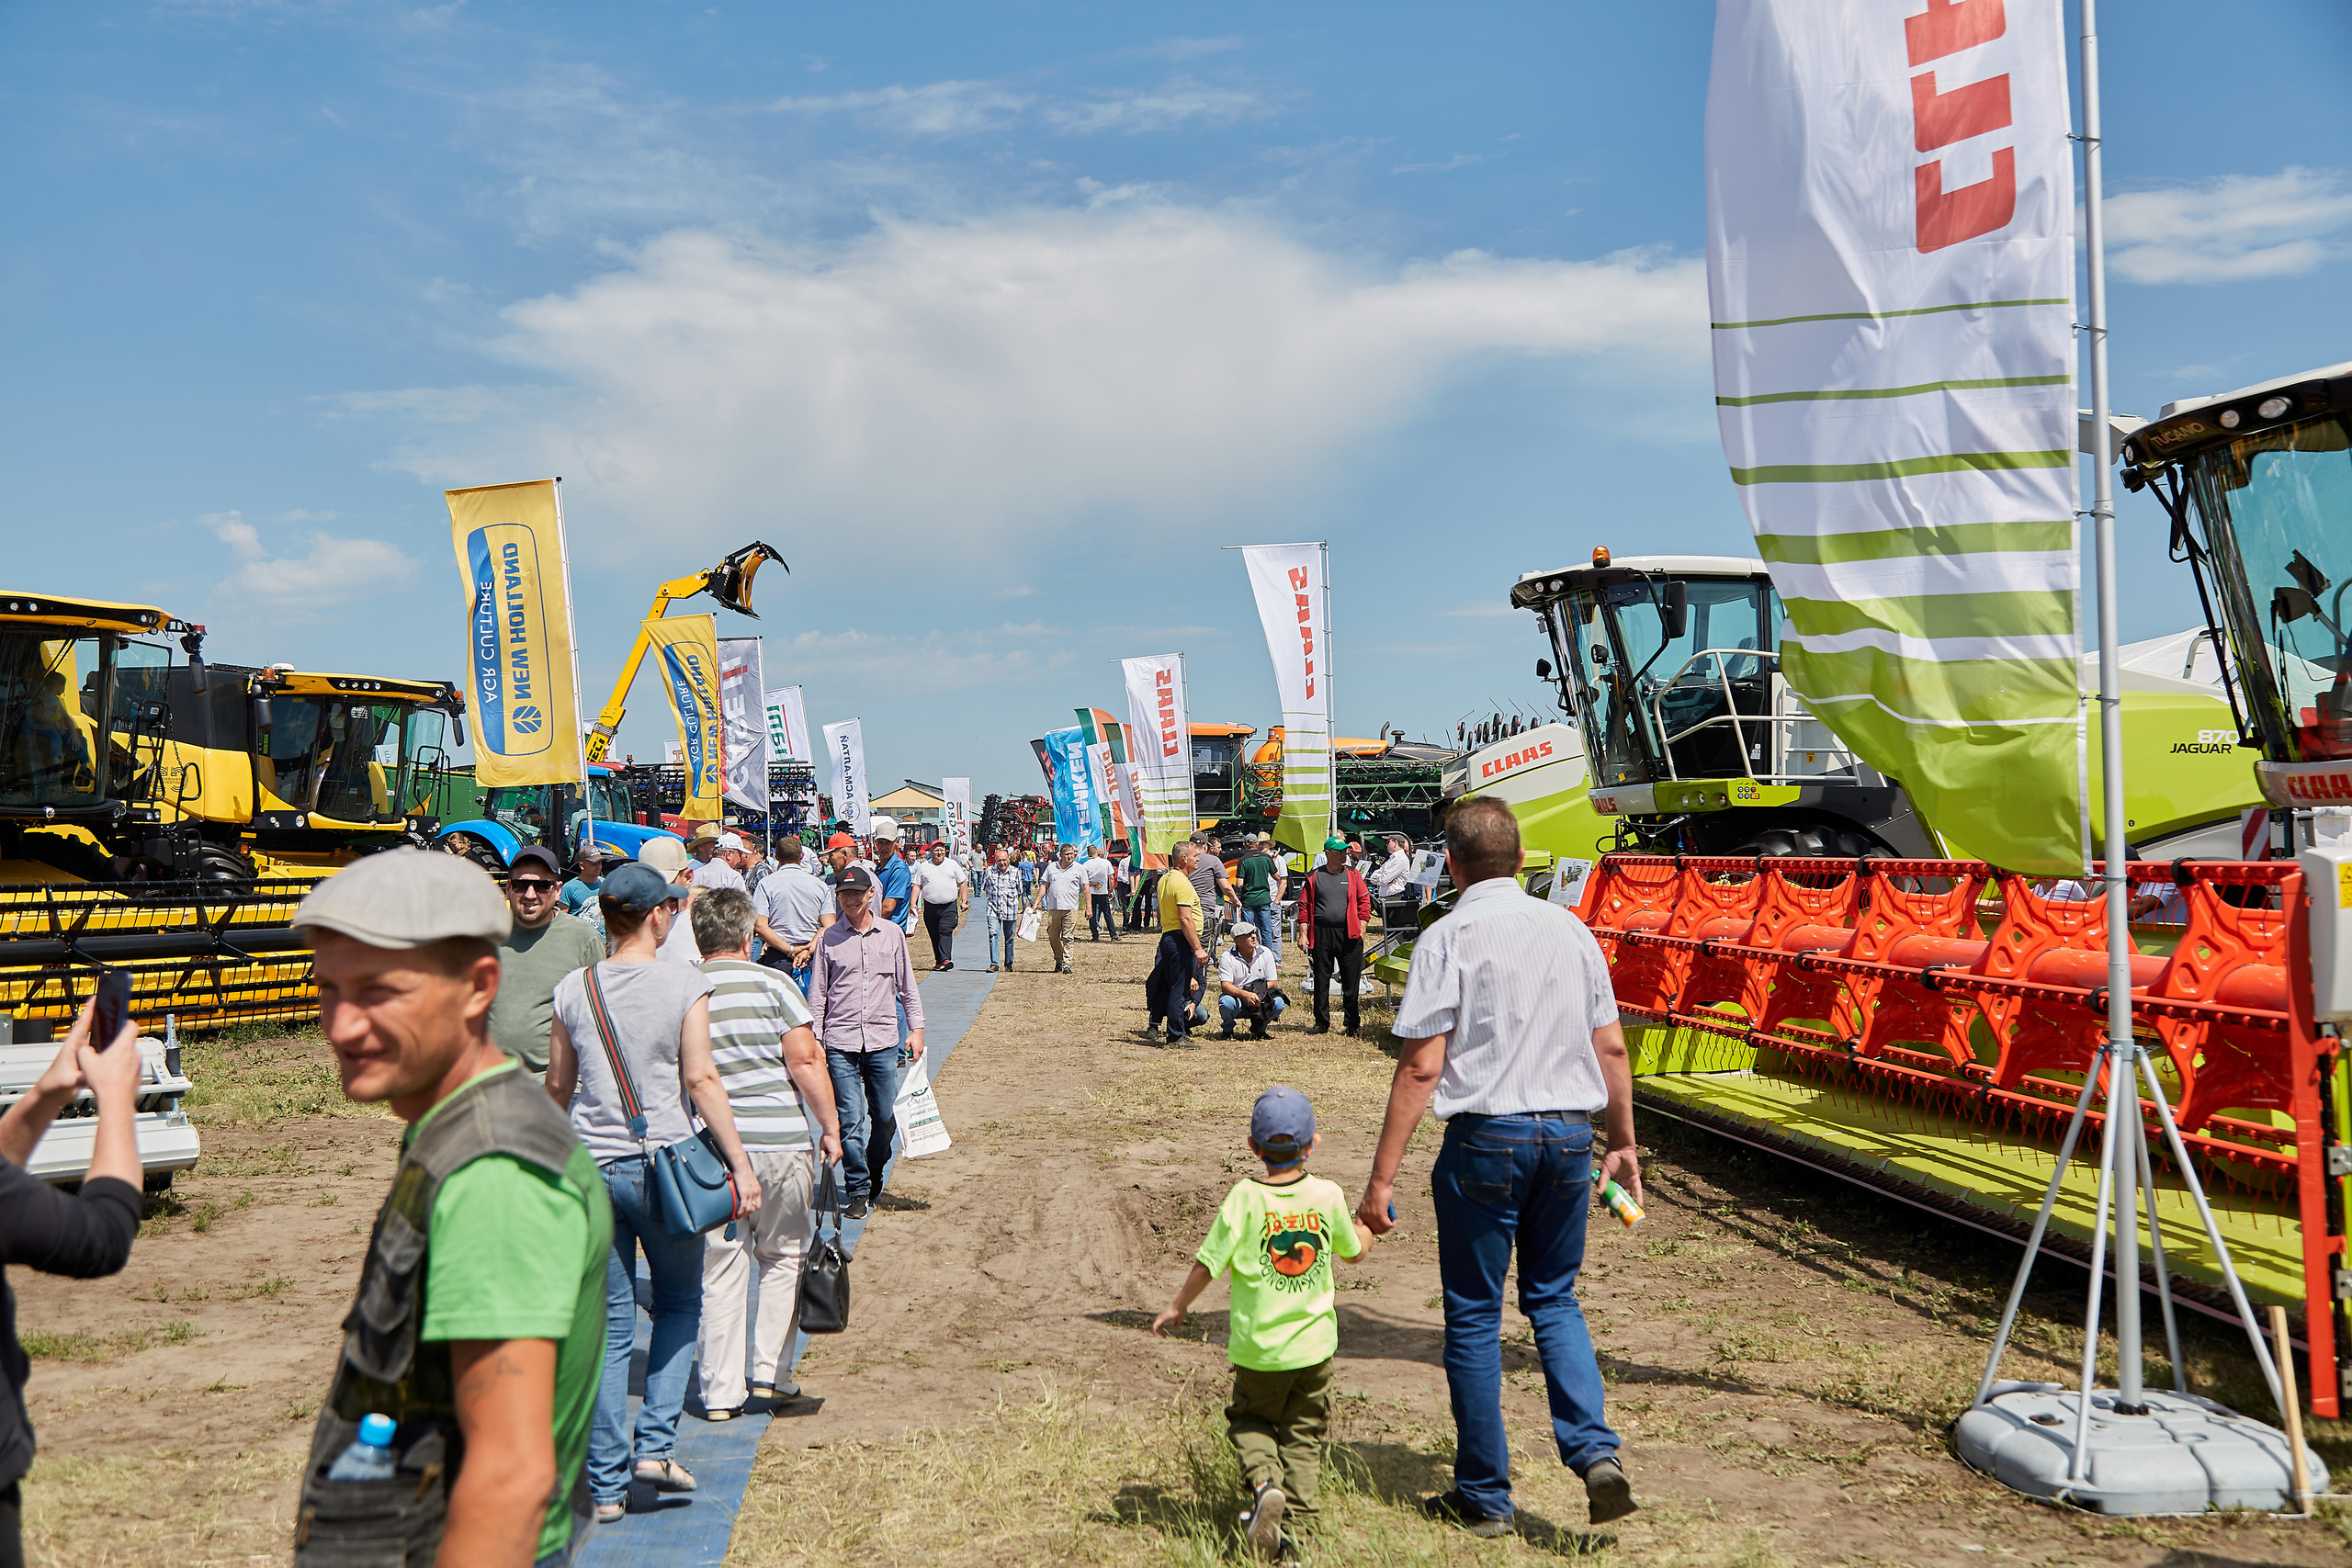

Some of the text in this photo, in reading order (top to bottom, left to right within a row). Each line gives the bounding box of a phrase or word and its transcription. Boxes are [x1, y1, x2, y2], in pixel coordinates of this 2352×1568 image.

[2150, 423, 2205, 446] TUCANO
[2170, 743, 2232, 754] JAGUAR
[2197, 729, 2239, 744] 870
[1482, 740, 1553, 778] CLAAS
[2287, 774, 2352, 800] CLAA
[1260, 1249, 1330, 1293] TAEKWONDO
